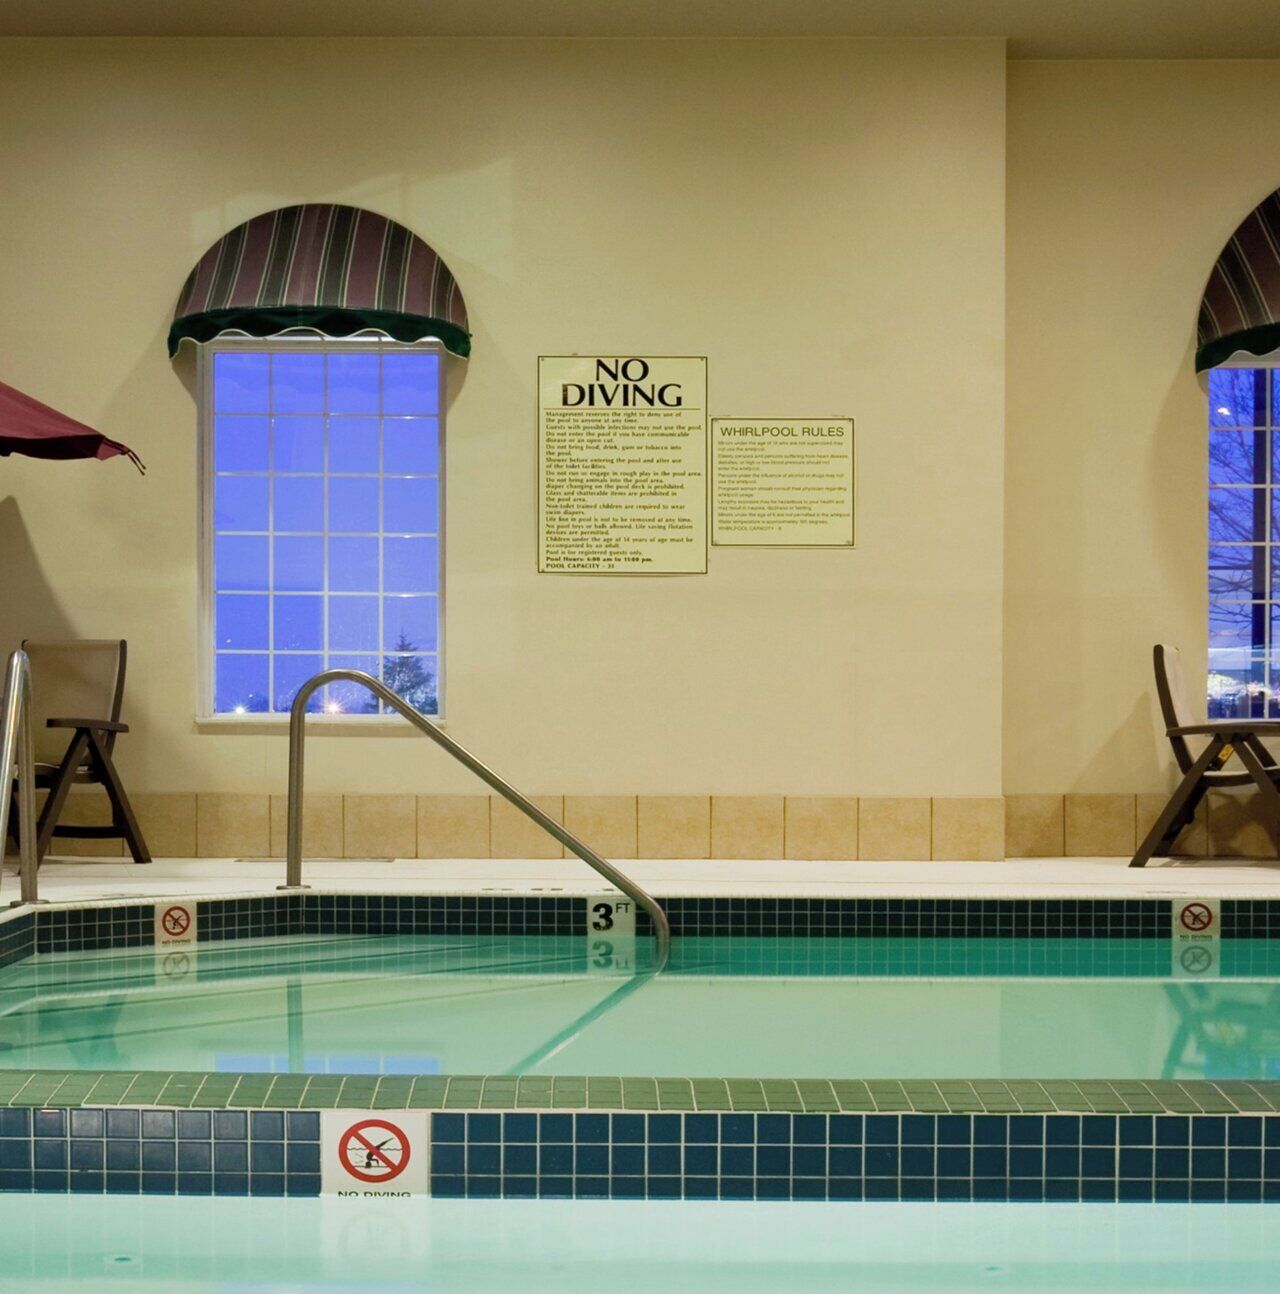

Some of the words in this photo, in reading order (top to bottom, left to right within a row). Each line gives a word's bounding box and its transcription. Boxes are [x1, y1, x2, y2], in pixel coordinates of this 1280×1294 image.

[595, 358, 649, 382] NO
[562, 383, 682, 407] DIVING
[720, 426, 798, 437] WHIRLPOOL
[802, 426, 845, 437] RULES
[592, 903, 614, 931] 3
[616, 903, 631, 913] FT
